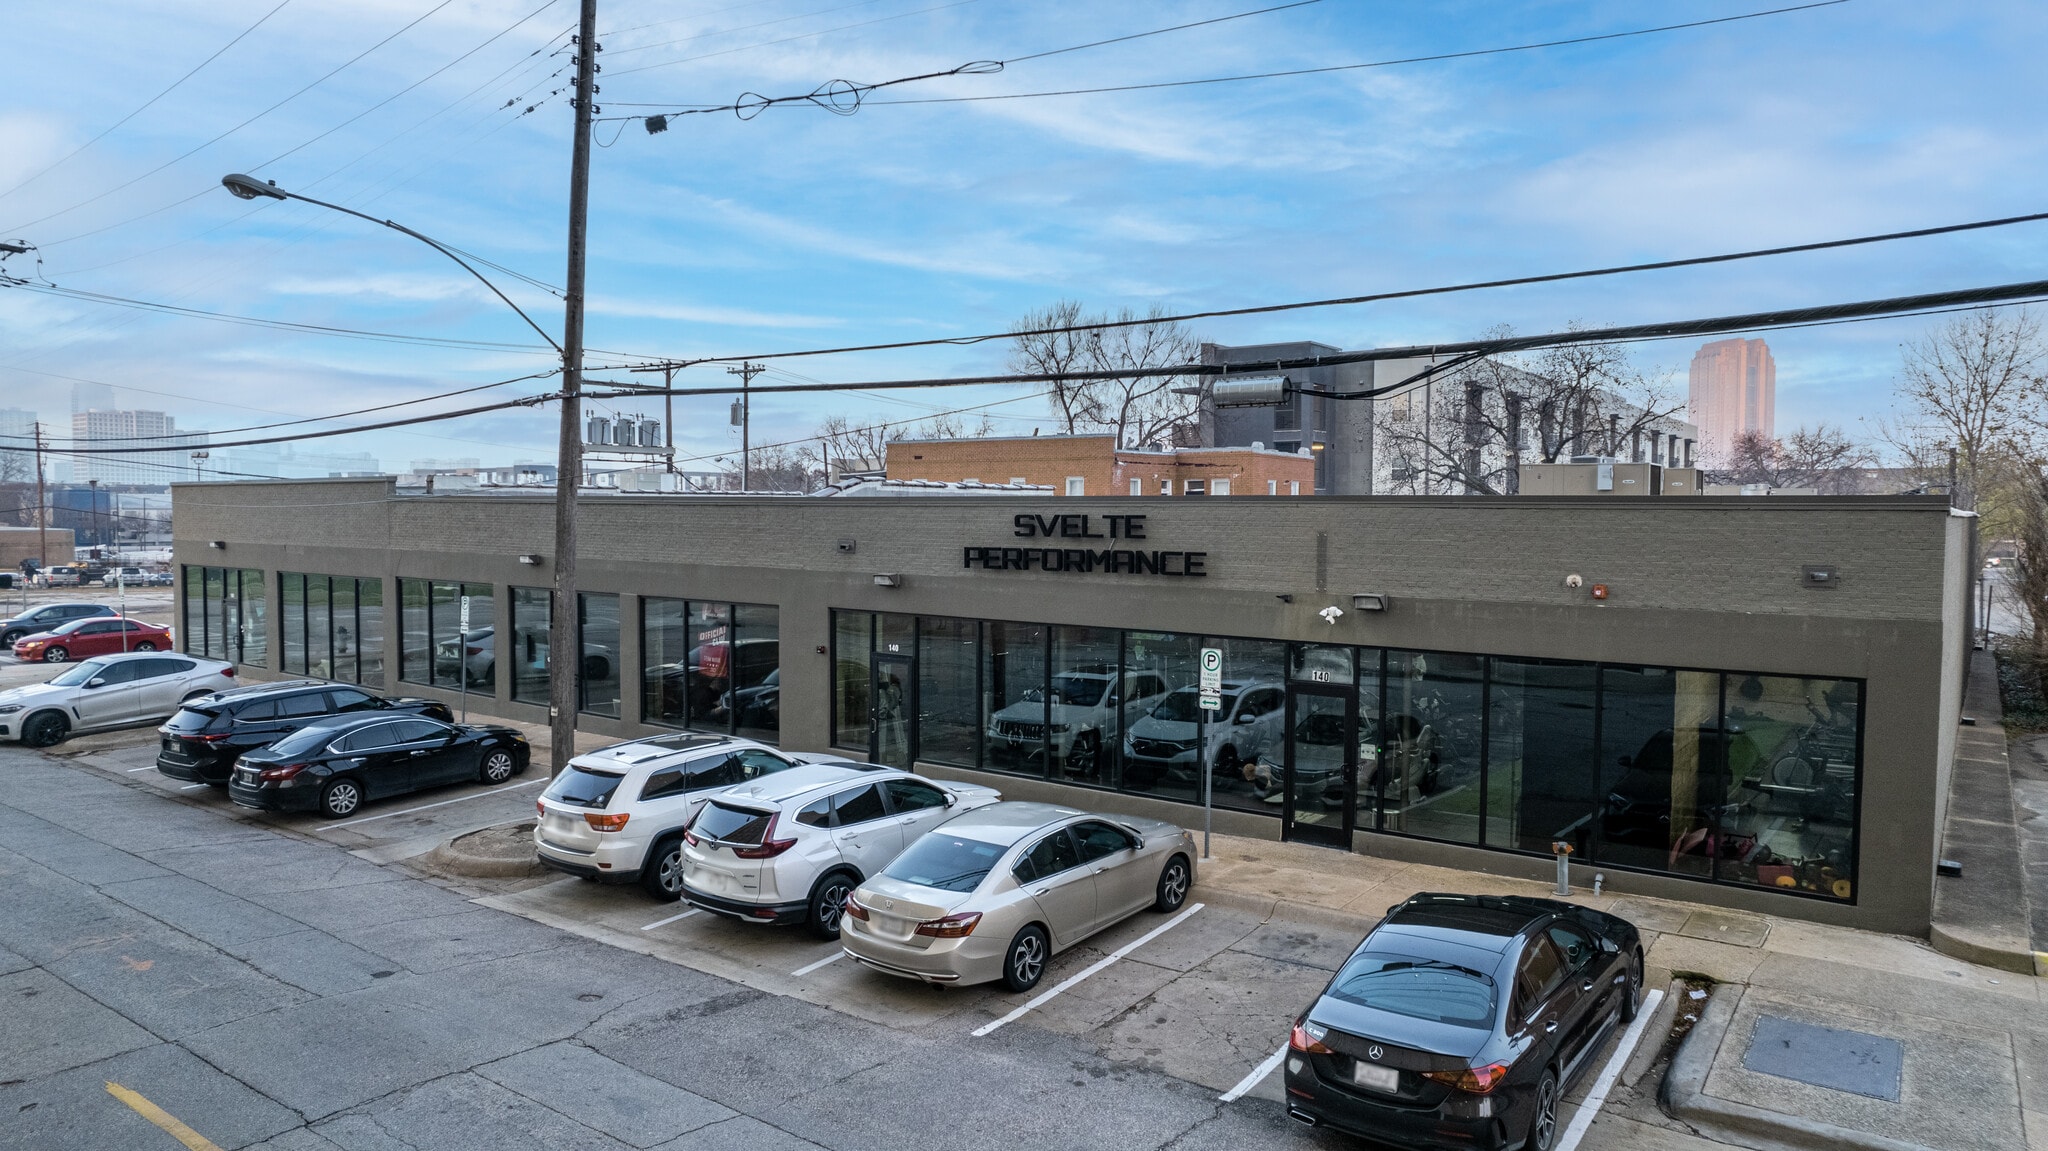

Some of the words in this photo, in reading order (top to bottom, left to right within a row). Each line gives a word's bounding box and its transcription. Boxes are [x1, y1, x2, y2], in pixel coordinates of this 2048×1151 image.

[1014, 514, 1146, 539] SVELTE
[964, 546, 1207, 577] PERFORMANCE
[888, 644, 899, 652] 140
[1207, 654, 1217, 667] P
[1313, 671, 1330, 682] 140
